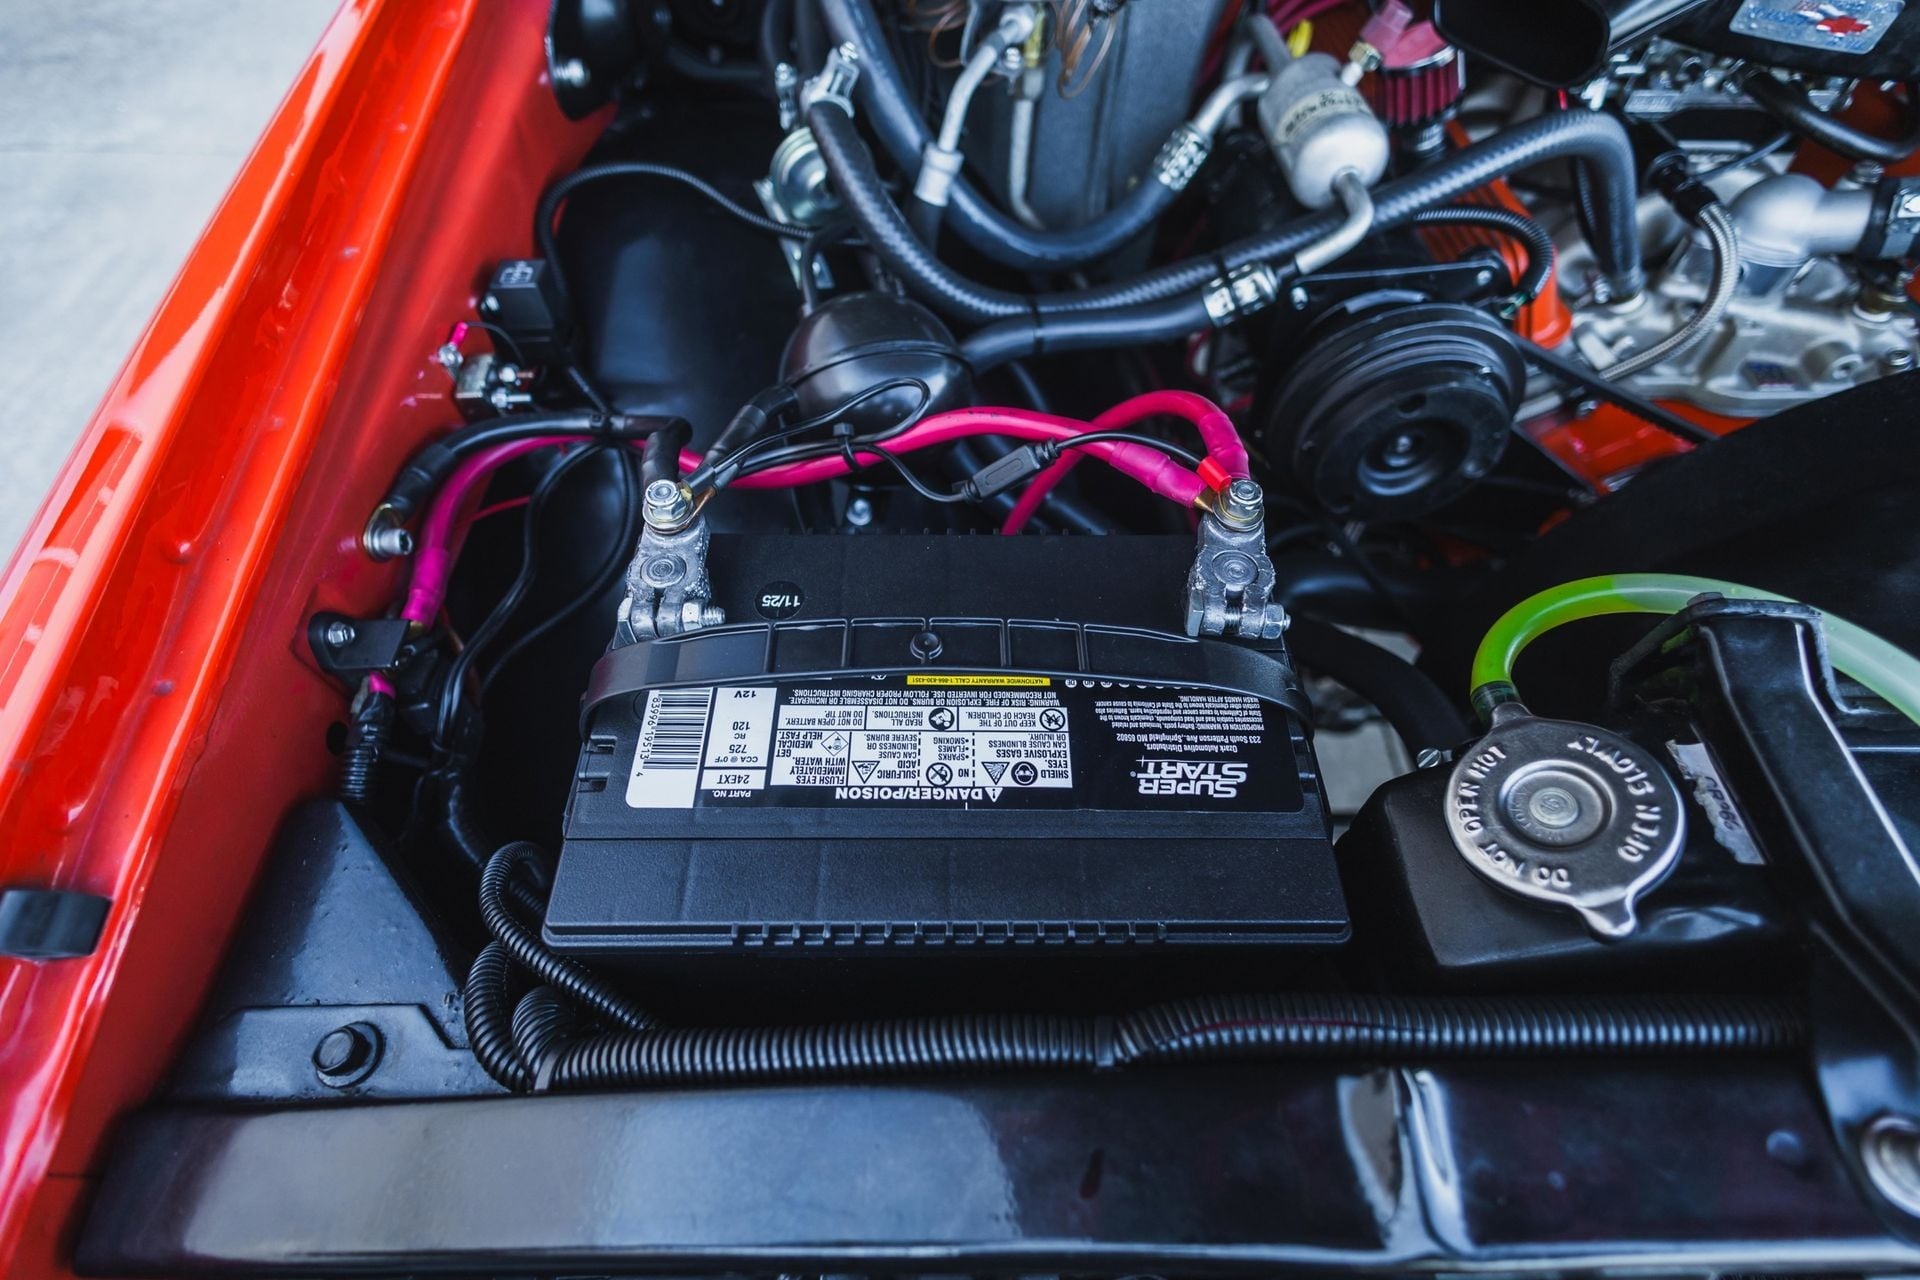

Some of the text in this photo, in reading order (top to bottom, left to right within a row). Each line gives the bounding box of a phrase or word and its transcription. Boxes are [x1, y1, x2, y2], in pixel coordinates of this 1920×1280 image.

[761, 594, 800, 608] 11/25
[647, 697, 661, 726] 83996
[732, 722, 750, 730] 120
[1116, 733, 1136, 742] 65802
[1136, 734, 1148, 742] MO
[1199, 735, 1229, 743] Patterson
[639, 732, 654, 760] 19513
[777, 740, 813, 748] MEDICAL
[1183, 744, 1218, 752] Automotive
[729, 744, 747, 754] 725
[776, 749, 792, 757] GET
[996, 749, 1067, 758] EXPLOSIVE GASES
[1219, 745, 1238, 753] Ozark
[792, 757, 846, 766] WITH WATER.
[897, 760, 917, 768] ACID
[1044, 759, 1068, 768] EYES.
[1470, 745, 1507, 778] HOT
[789, 766, 845, 775] IMMEDIATELY
[877, 769, 917, 779] SULFURIC
[958, 768, 969, 777] NO
[1041, 770, 1069, 778] SHIELD
[717, 774, 750, 784] 24EXT
[795, 775, 844, 784] FLUSH EYES
[1138, 779, 1238, 798] SUPER
[835, 787, 983, 800] DANGER/POISON
[1457, 782, 1484, 834] OPEN
[1479, 842, 1526, 877] NOT
[1533, 867, 1572, 889] DO
